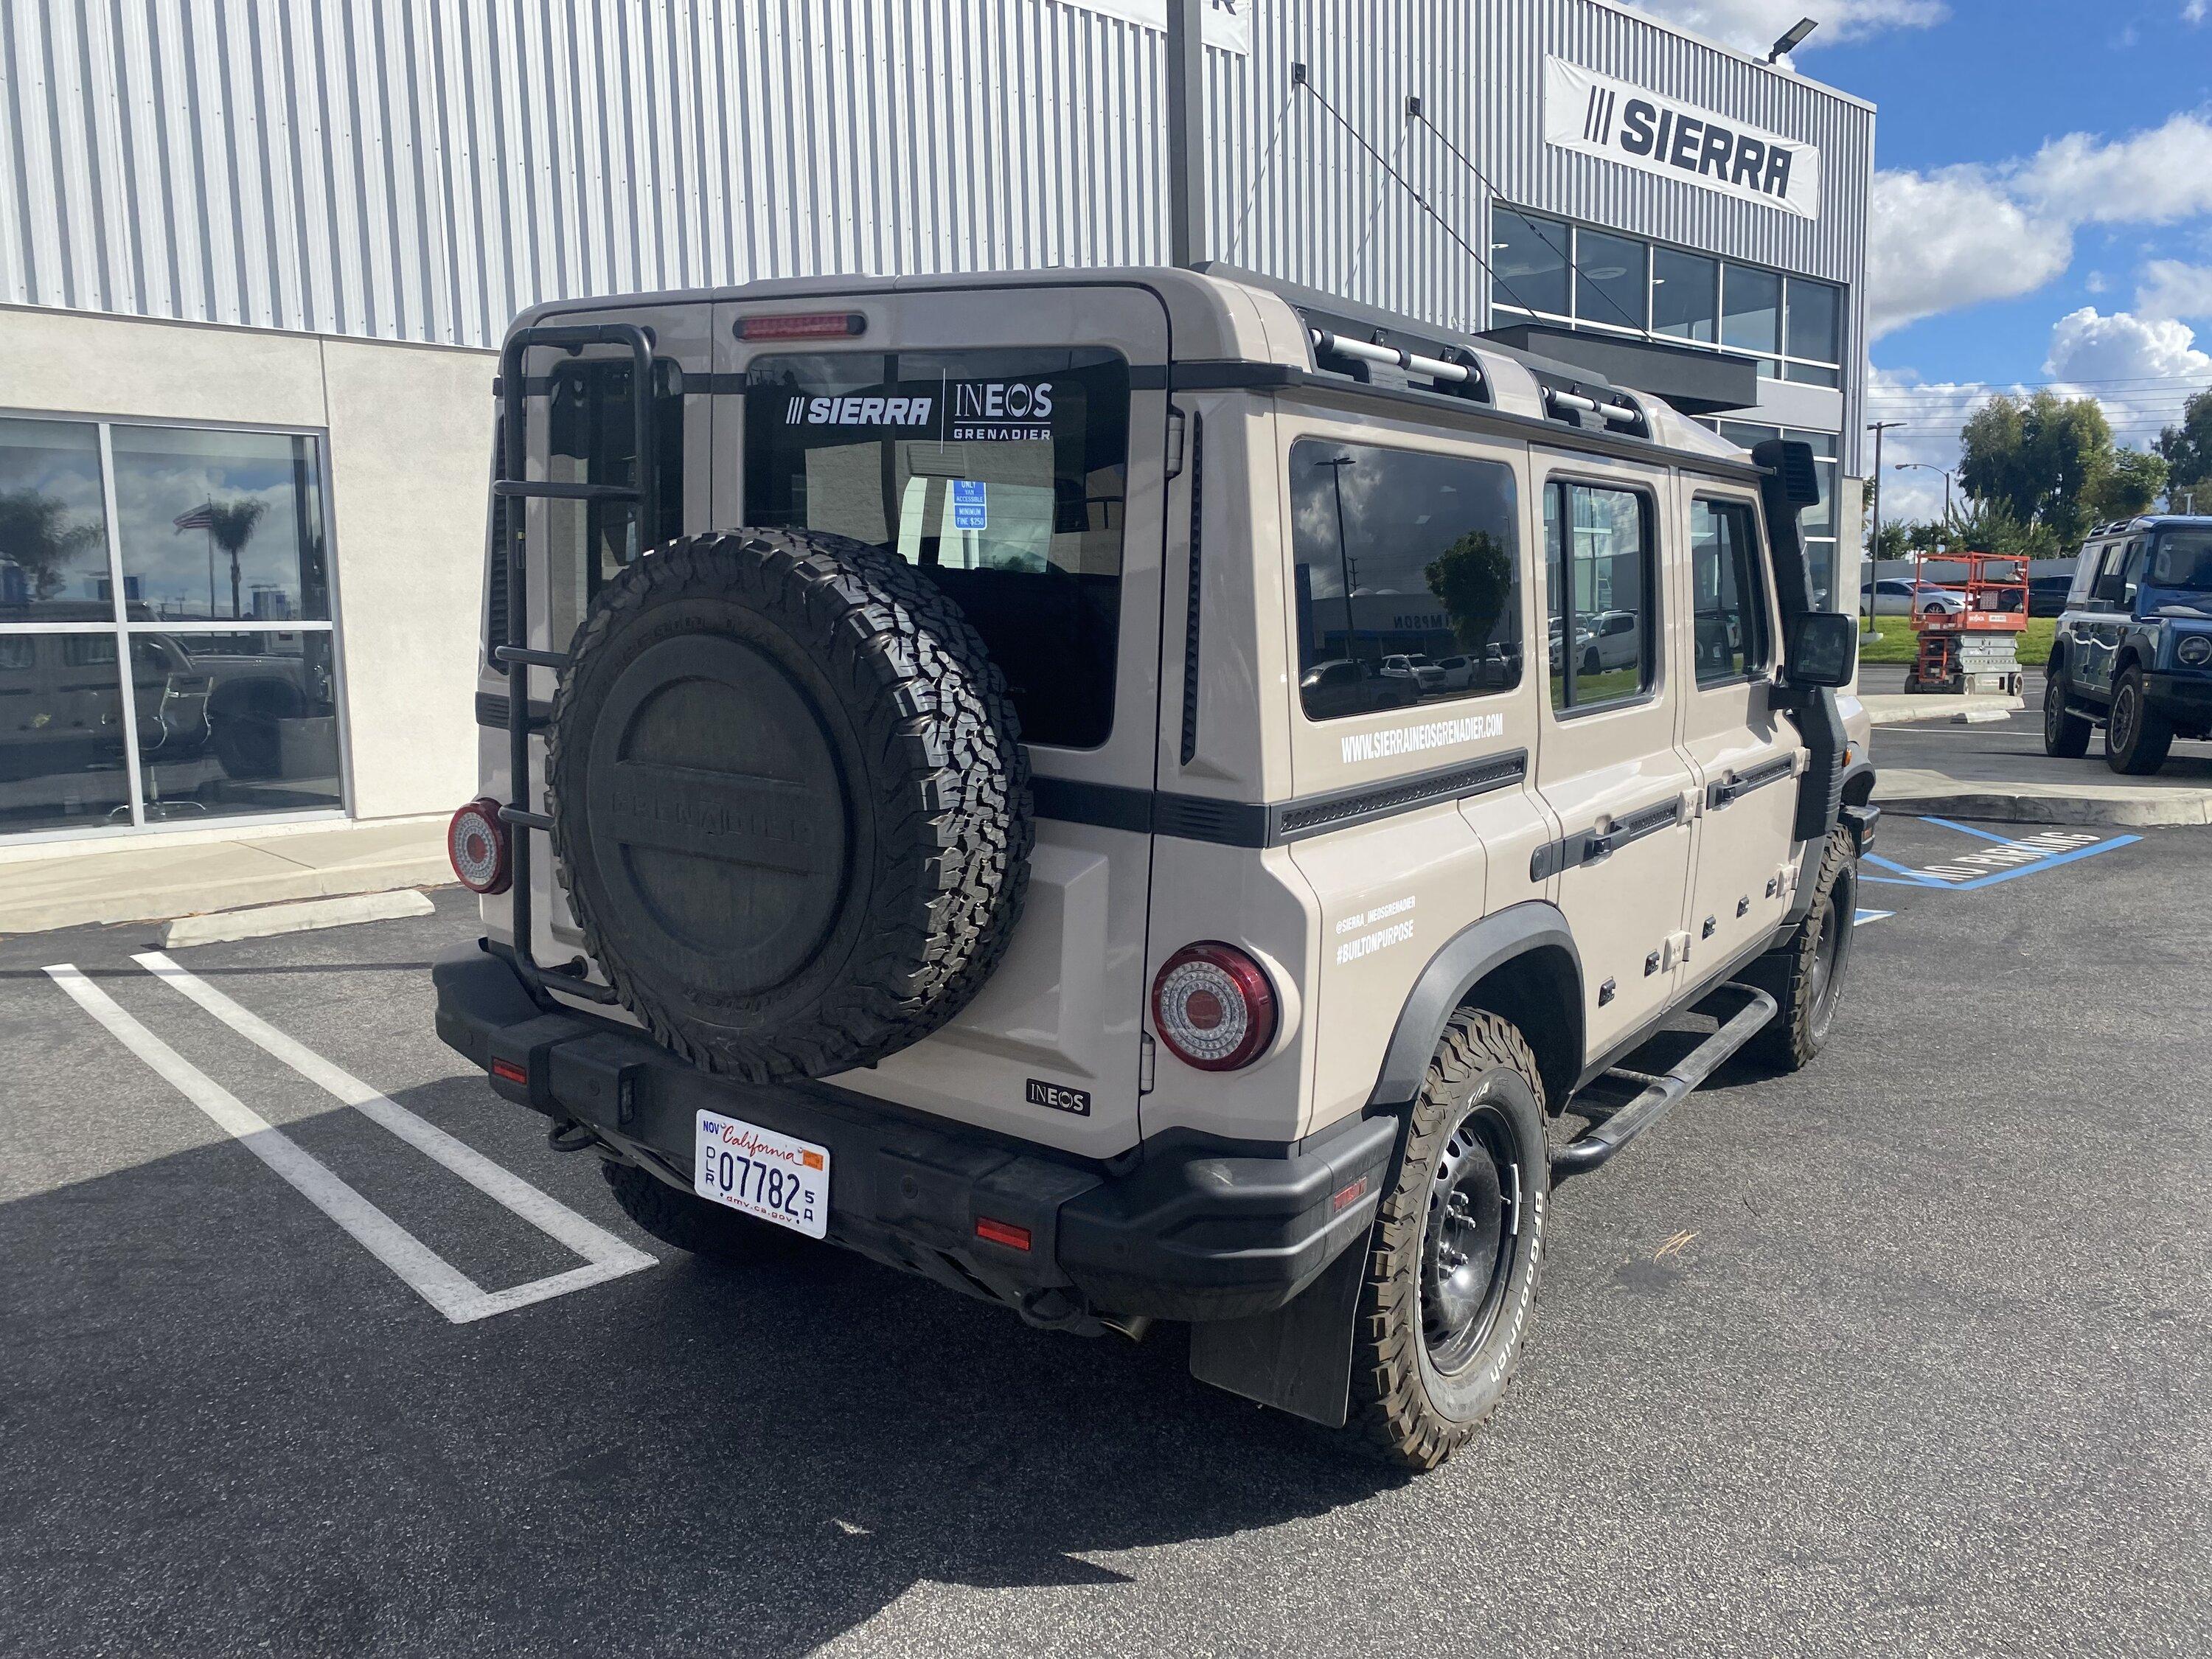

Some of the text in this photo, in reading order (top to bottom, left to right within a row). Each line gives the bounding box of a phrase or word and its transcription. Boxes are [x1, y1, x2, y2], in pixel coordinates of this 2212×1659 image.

[1620, 98, 1792, 199] SIERRA
[807, 397, 932, 425] SIERRA
[954, 382, 1054, 418] INEOS
[953, 428, 1051, 440] GRENADIER
[956, 517, 984, 526] FINE $250
[959, 507, 981, 516] MINIMUM
[1340, 712, 1503, 764] WWW.SIERRAINEOSGRENADIER.COM
[1900, 832, 2101, 881] NO PARKING
[1336, 919, 1414, 967] #BUILTONPURPOSE
[1031, 1083, 1084, 1111] INEOS
[703, 1120, 720, 1135] NOV
[723, 1125, 804, 1166] California
[720, 1151, 800, 1217] 07782
[726, 1195, 792, 1222] dmv.ca.gov
[1489, 1191, 1543, 1384] BFGoodrich
